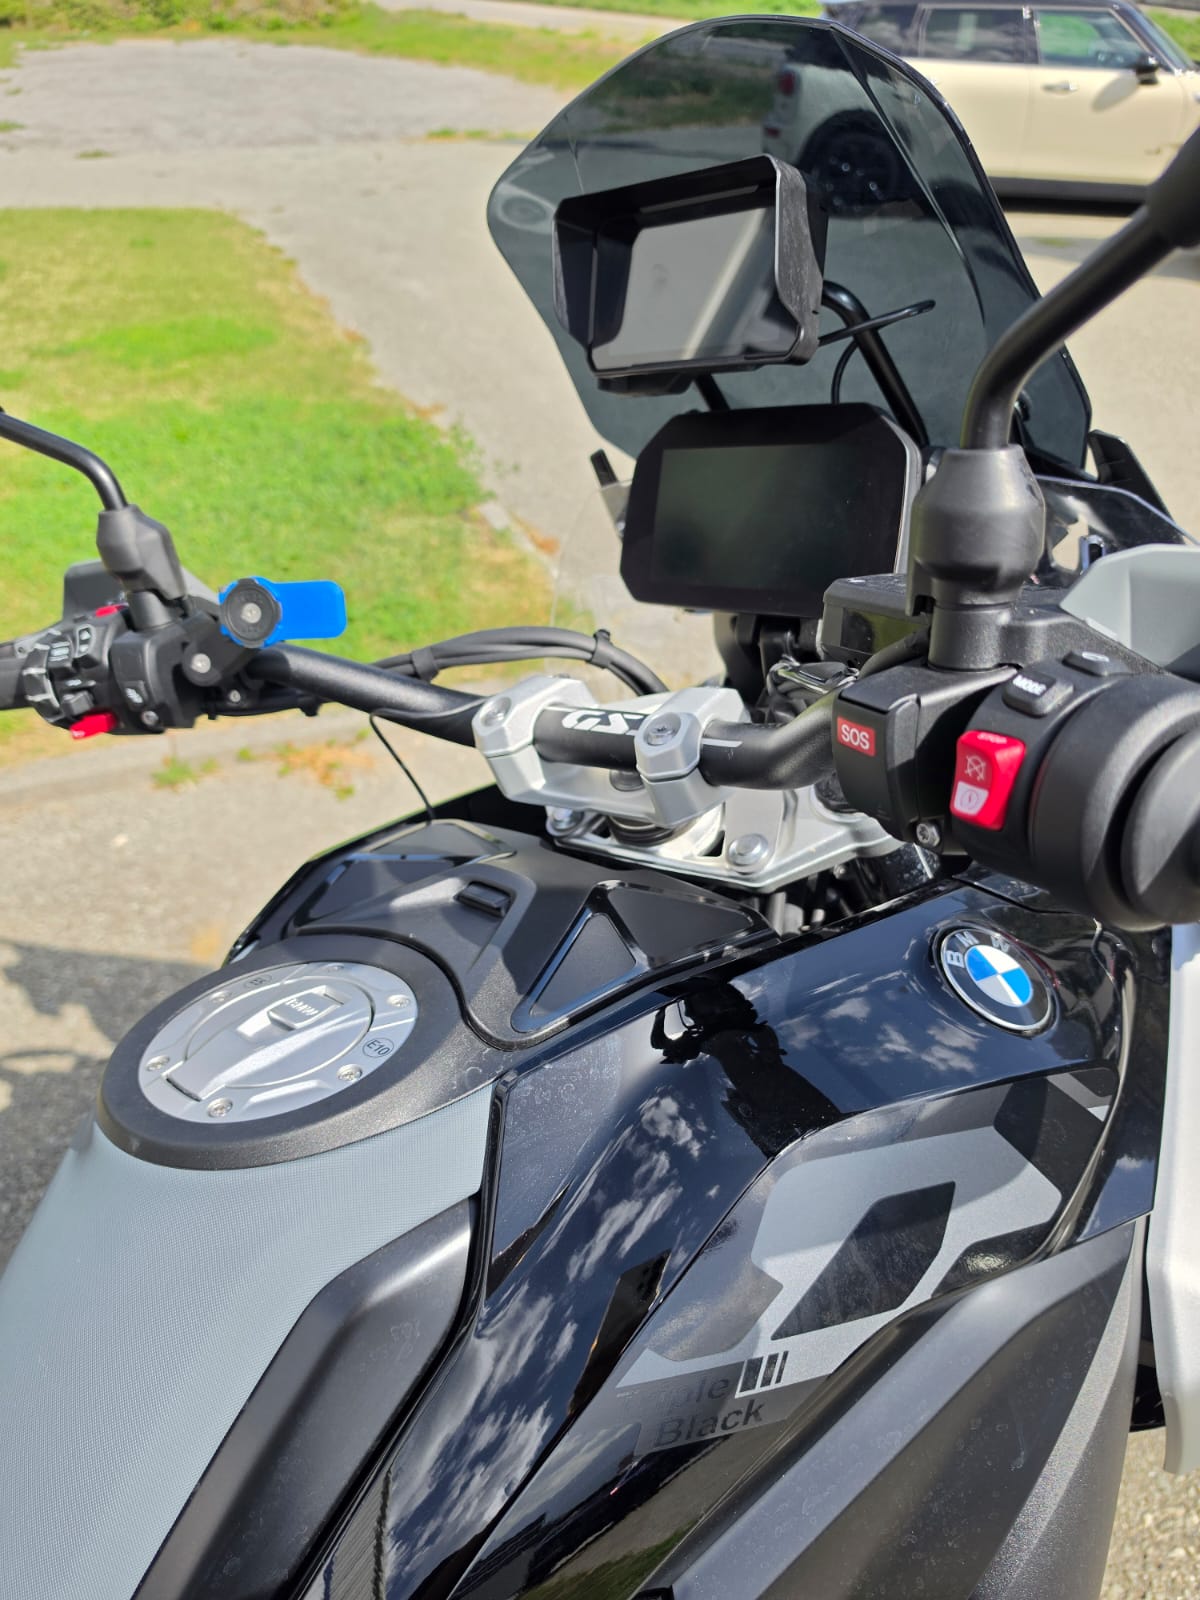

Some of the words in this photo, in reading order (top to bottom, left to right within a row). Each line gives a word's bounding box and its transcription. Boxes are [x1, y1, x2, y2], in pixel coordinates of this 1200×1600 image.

[562, 710, 645, 735] GS
[841, 723, 870, 750] SOS
[944, 929, 1011, 969] BMW
[366, 1039, 391, 1056] E10
[653, 1399, 767, 1447] Black
